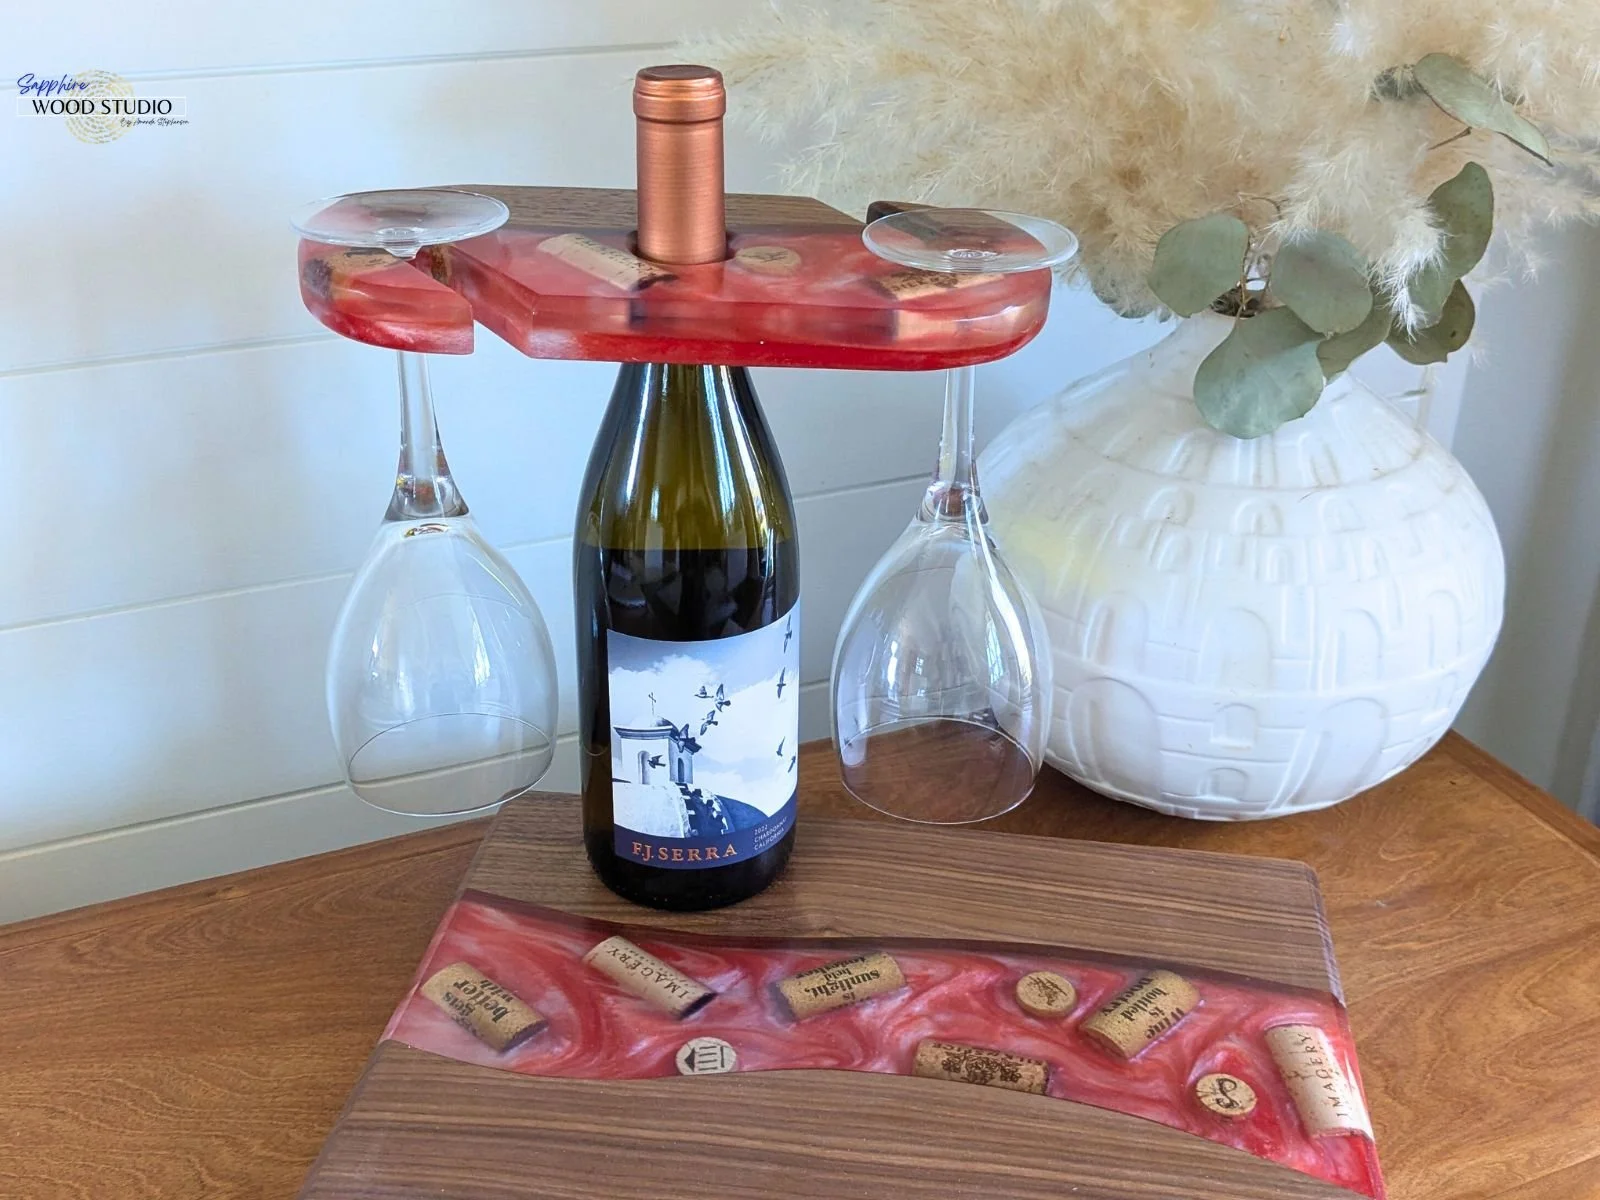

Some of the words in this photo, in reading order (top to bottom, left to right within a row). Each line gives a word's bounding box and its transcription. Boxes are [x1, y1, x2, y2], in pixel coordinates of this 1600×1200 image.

[754, 824, 768, 836] 2022
[658, 843, 738, 862] SERRA
[606, 947, 690, 998] IMAGERY
[803, 968, 881, 999] sunlight,
[453, 979, 510, 1023] better
[1120, 987, 1170, 1022] bottled
[1148, 1006, 1166, 1019] is
[1297, 1033, 1349, 1117] IMAGERY
